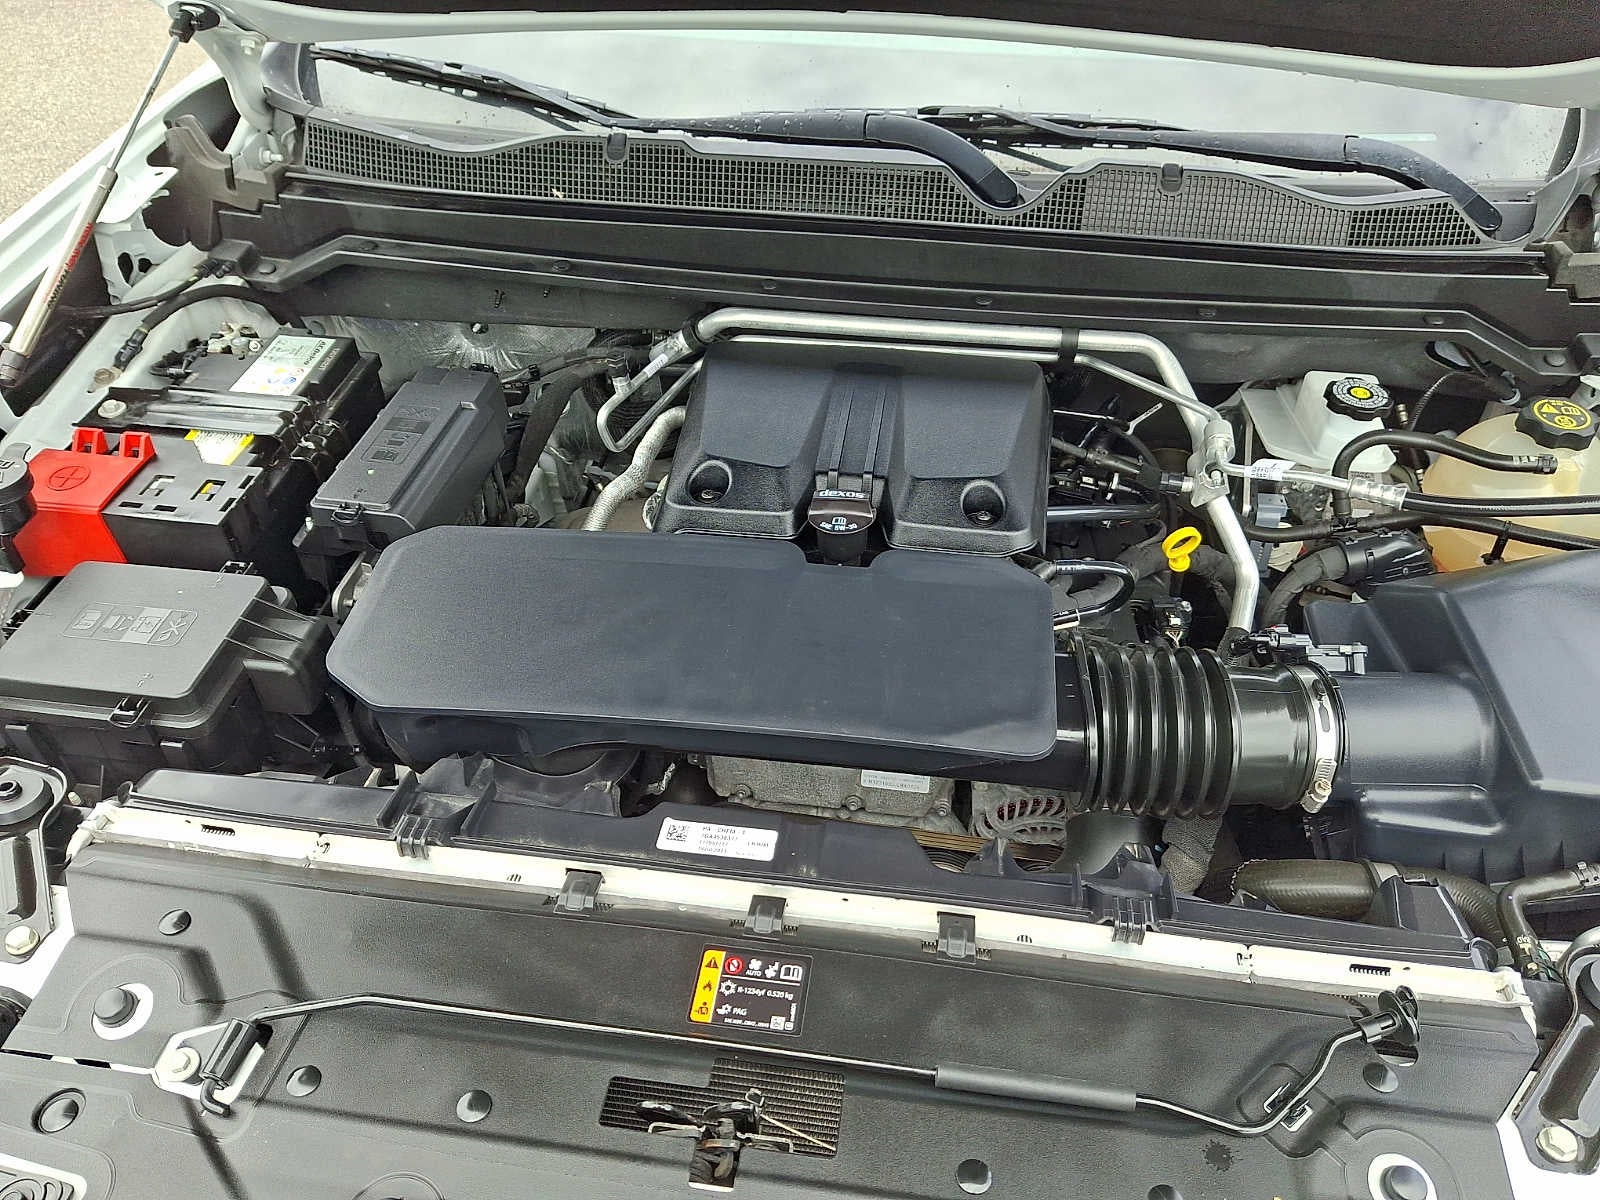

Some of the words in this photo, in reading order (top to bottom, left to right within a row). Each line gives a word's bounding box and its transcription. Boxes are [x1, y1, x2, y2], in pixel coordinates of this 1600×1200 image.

[819, 489, 866, 498] dexos
[745, 969, 762, 977] AUTO
[784, 991, 794, 1001] kg
[732, 1007, 747, 1016] PAG
